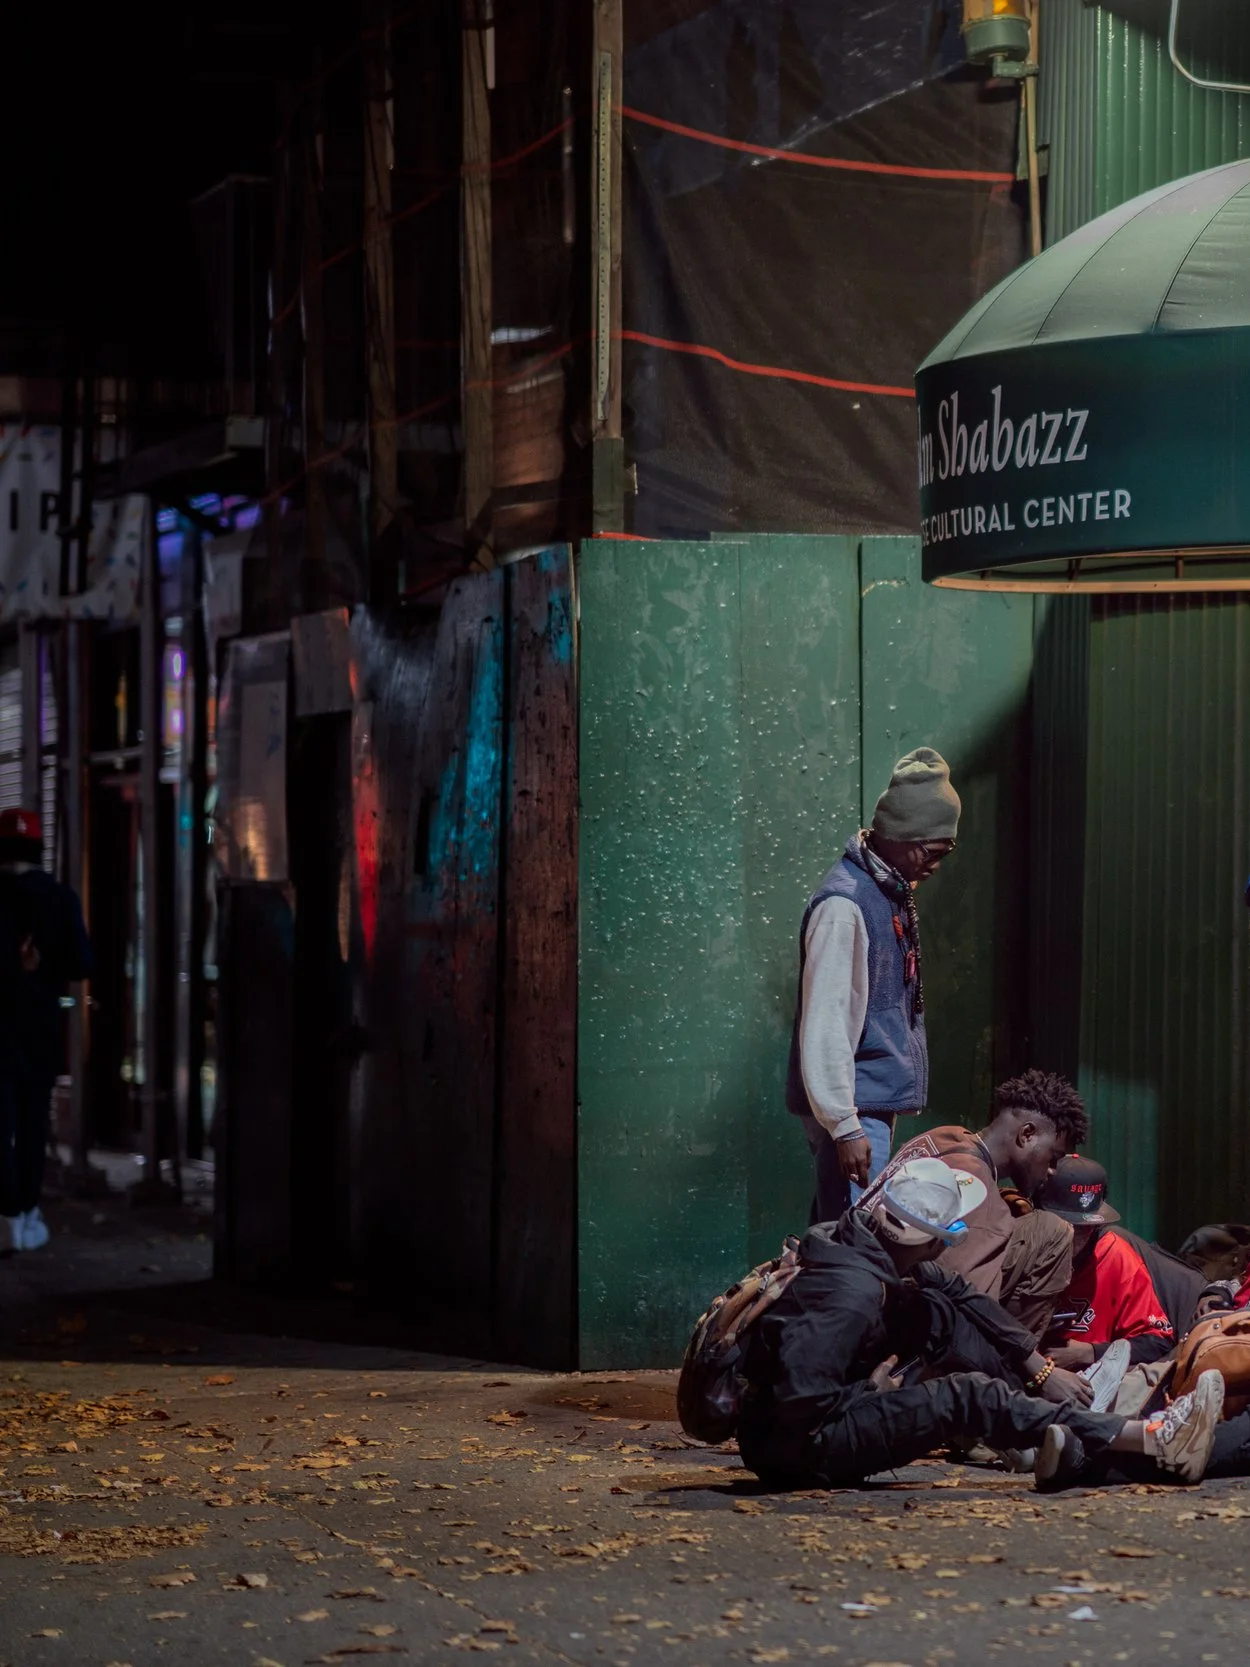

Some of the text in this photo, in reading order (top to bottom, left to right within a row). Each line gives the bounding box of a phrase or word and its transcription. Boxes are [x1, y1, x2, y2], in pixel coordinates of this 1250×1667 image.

[937, 384, 1090, 481] Shabazz
[930, 502, 1016, 544] CULTURAL
[1023, 489, 1133, 529] CENTER
